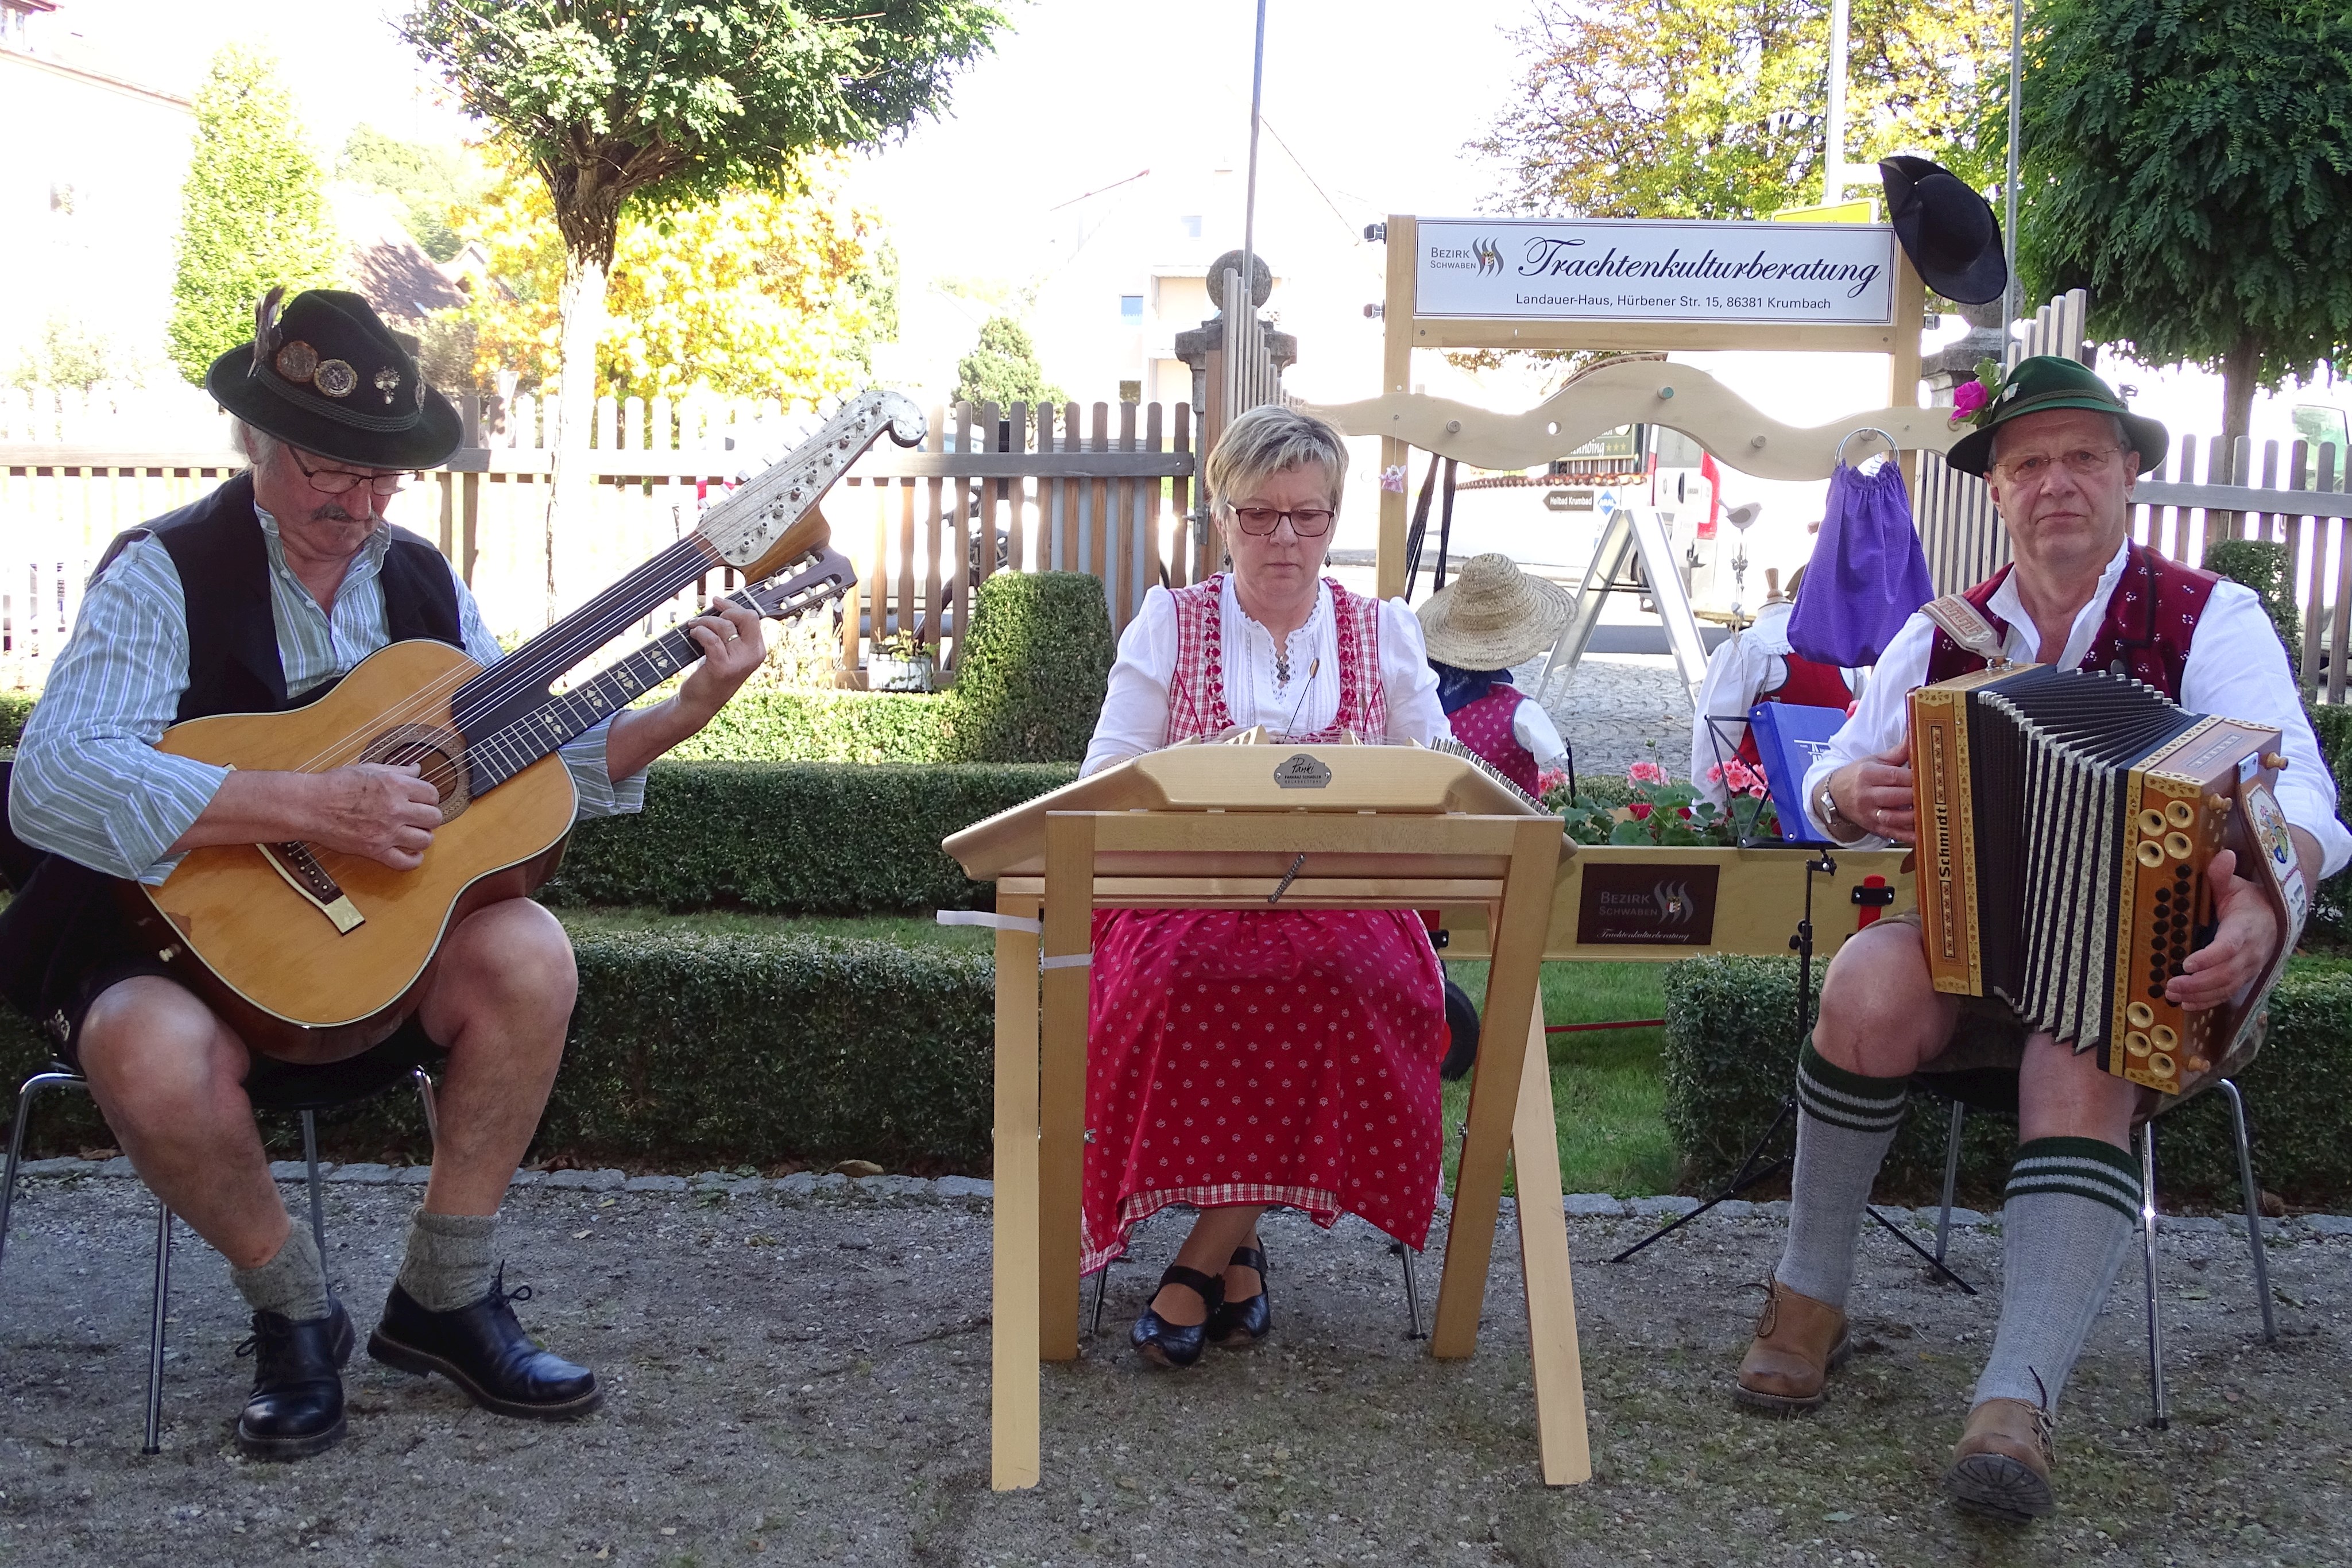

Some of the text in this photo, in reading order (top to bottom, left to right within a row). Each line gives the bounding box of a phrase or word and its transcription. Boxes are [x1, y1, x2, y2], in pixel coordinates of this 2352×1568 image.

[1431, 247, 1470, 258] BEZIRK
[1430, 260, 1476, 269] SCHWABEN
[1518, 237, 1881, 299] Trachtenkulturberatung
[1516, 293, 1831, 309] Landauer-Haus, Hürbener Str. 15, 86381 Krumbach
[1550, 496, 1593, 506] Heilbad Krumbad
[1599, 498, 1616, 507] ARAL
[1292, 757, 1316, 775] Panki
[1936, 806, 1951, 878] Schmidt
[1600, 891, 1651, 904] BEZIRK
[1599, 905, 1658, 916] SCHWABEN
[1596, 928, 1690, 942] Trachtenkulturberatung
